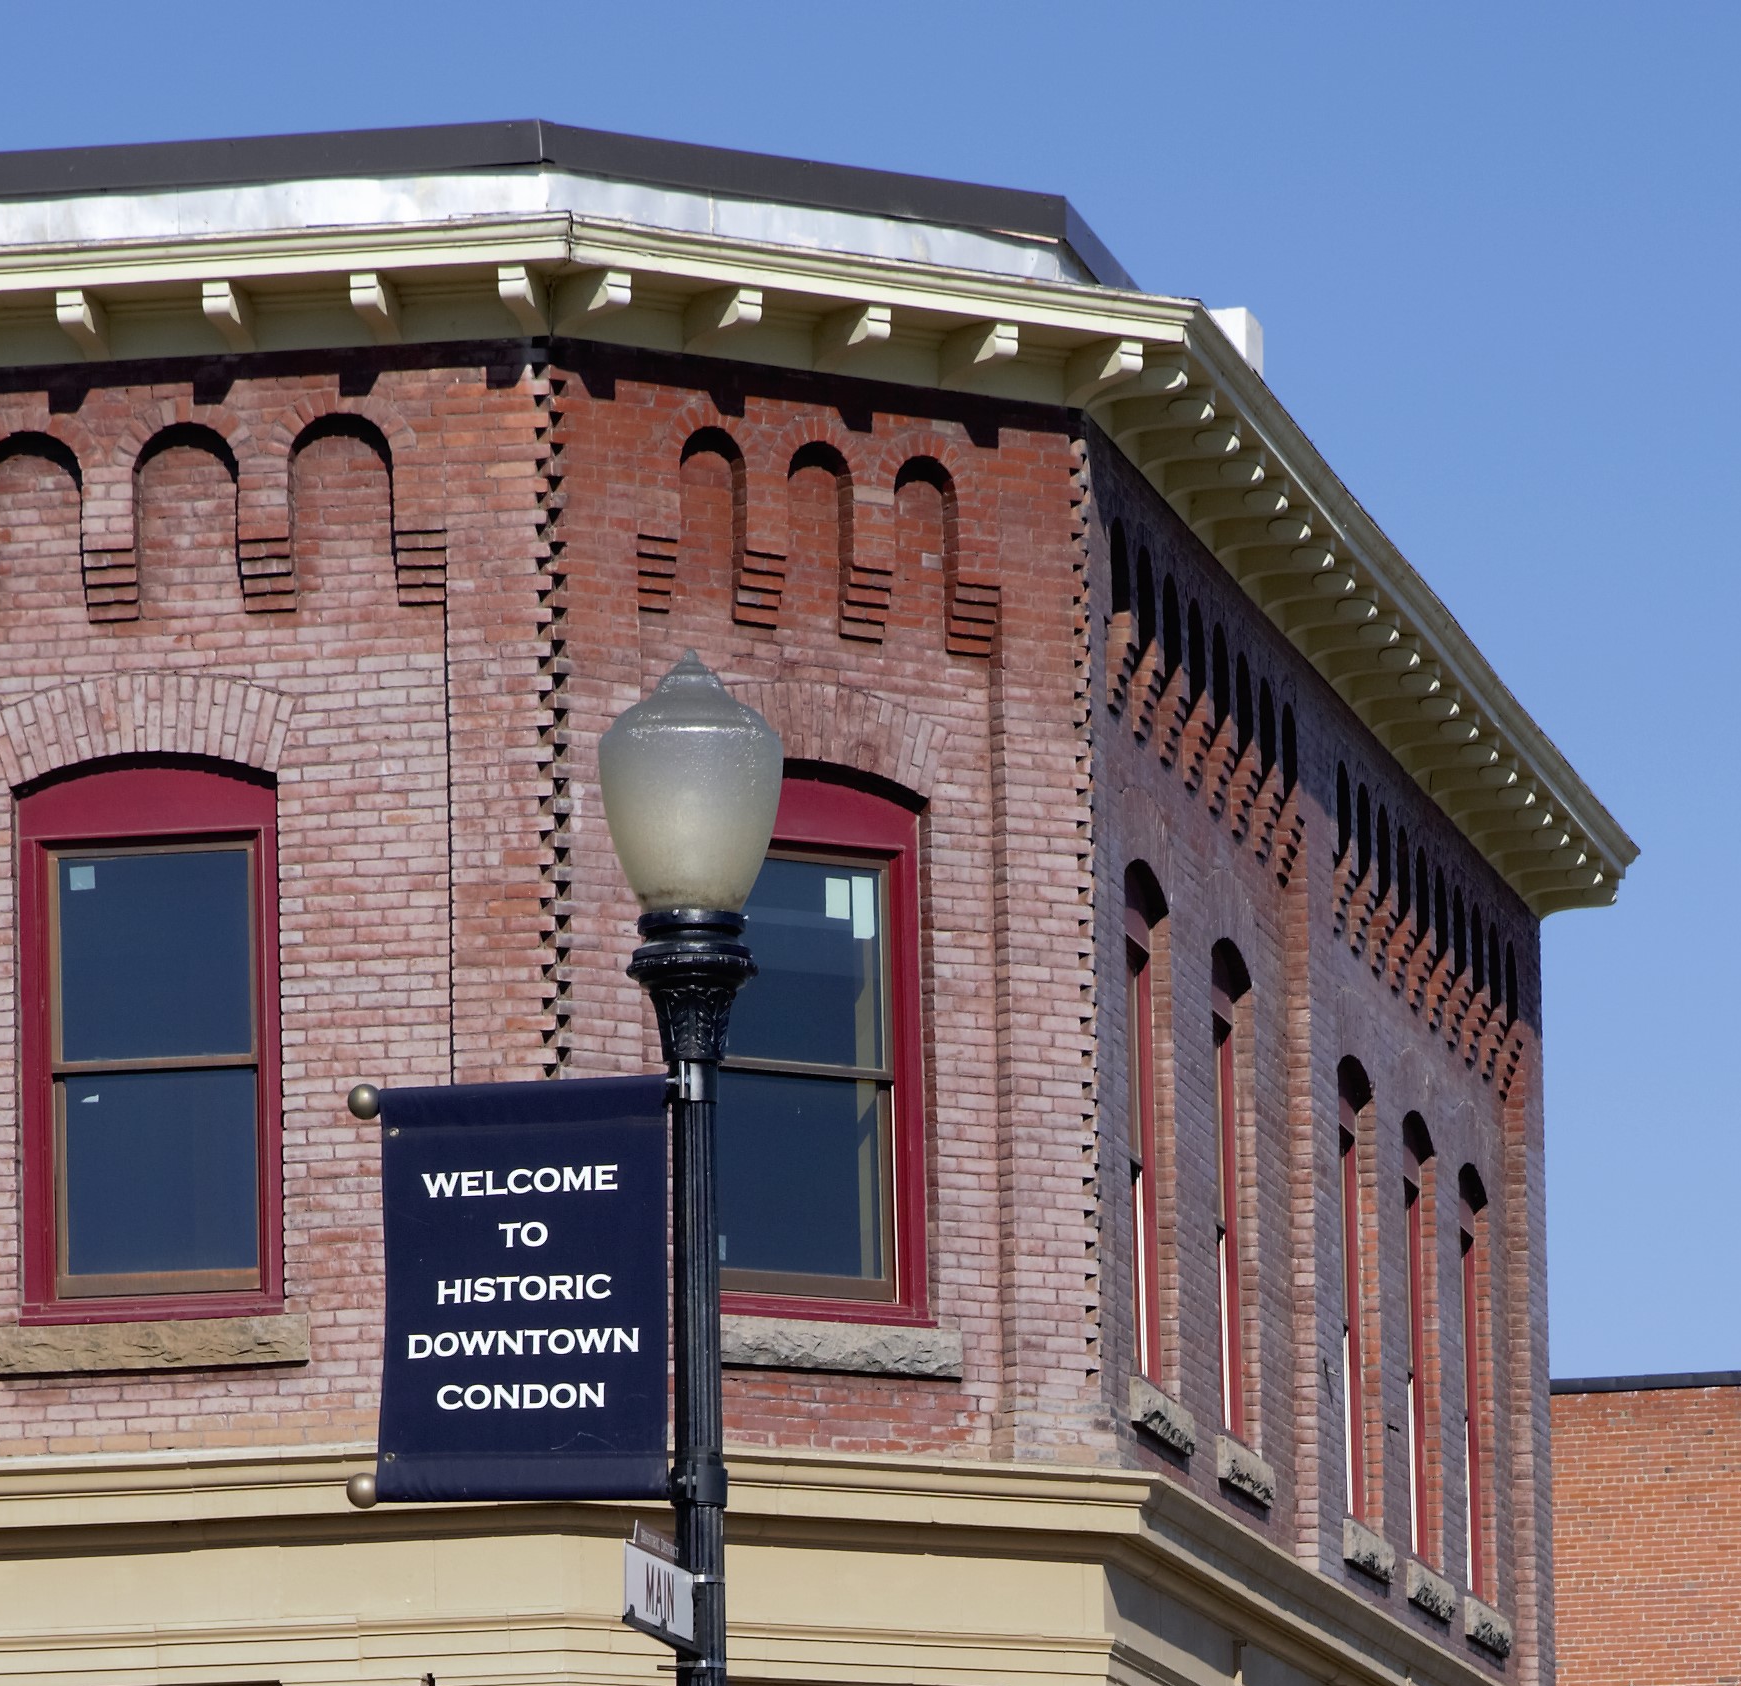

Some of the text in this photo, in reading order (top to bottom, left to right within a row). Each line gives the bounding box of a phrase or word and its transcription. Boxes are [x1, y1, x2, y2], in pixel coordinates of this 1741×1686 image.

[421, 1163, 619, 1198] WELCOME
[498, 1221, 549, 1248] TO
[436, 1273, 613, 1305] HISTORIC
[407, 1327, 640, 1360] DOWNTOWN
[436, 1382, 606, 1411] CONDON
[645, 1562, 675, 1624] MAIN
